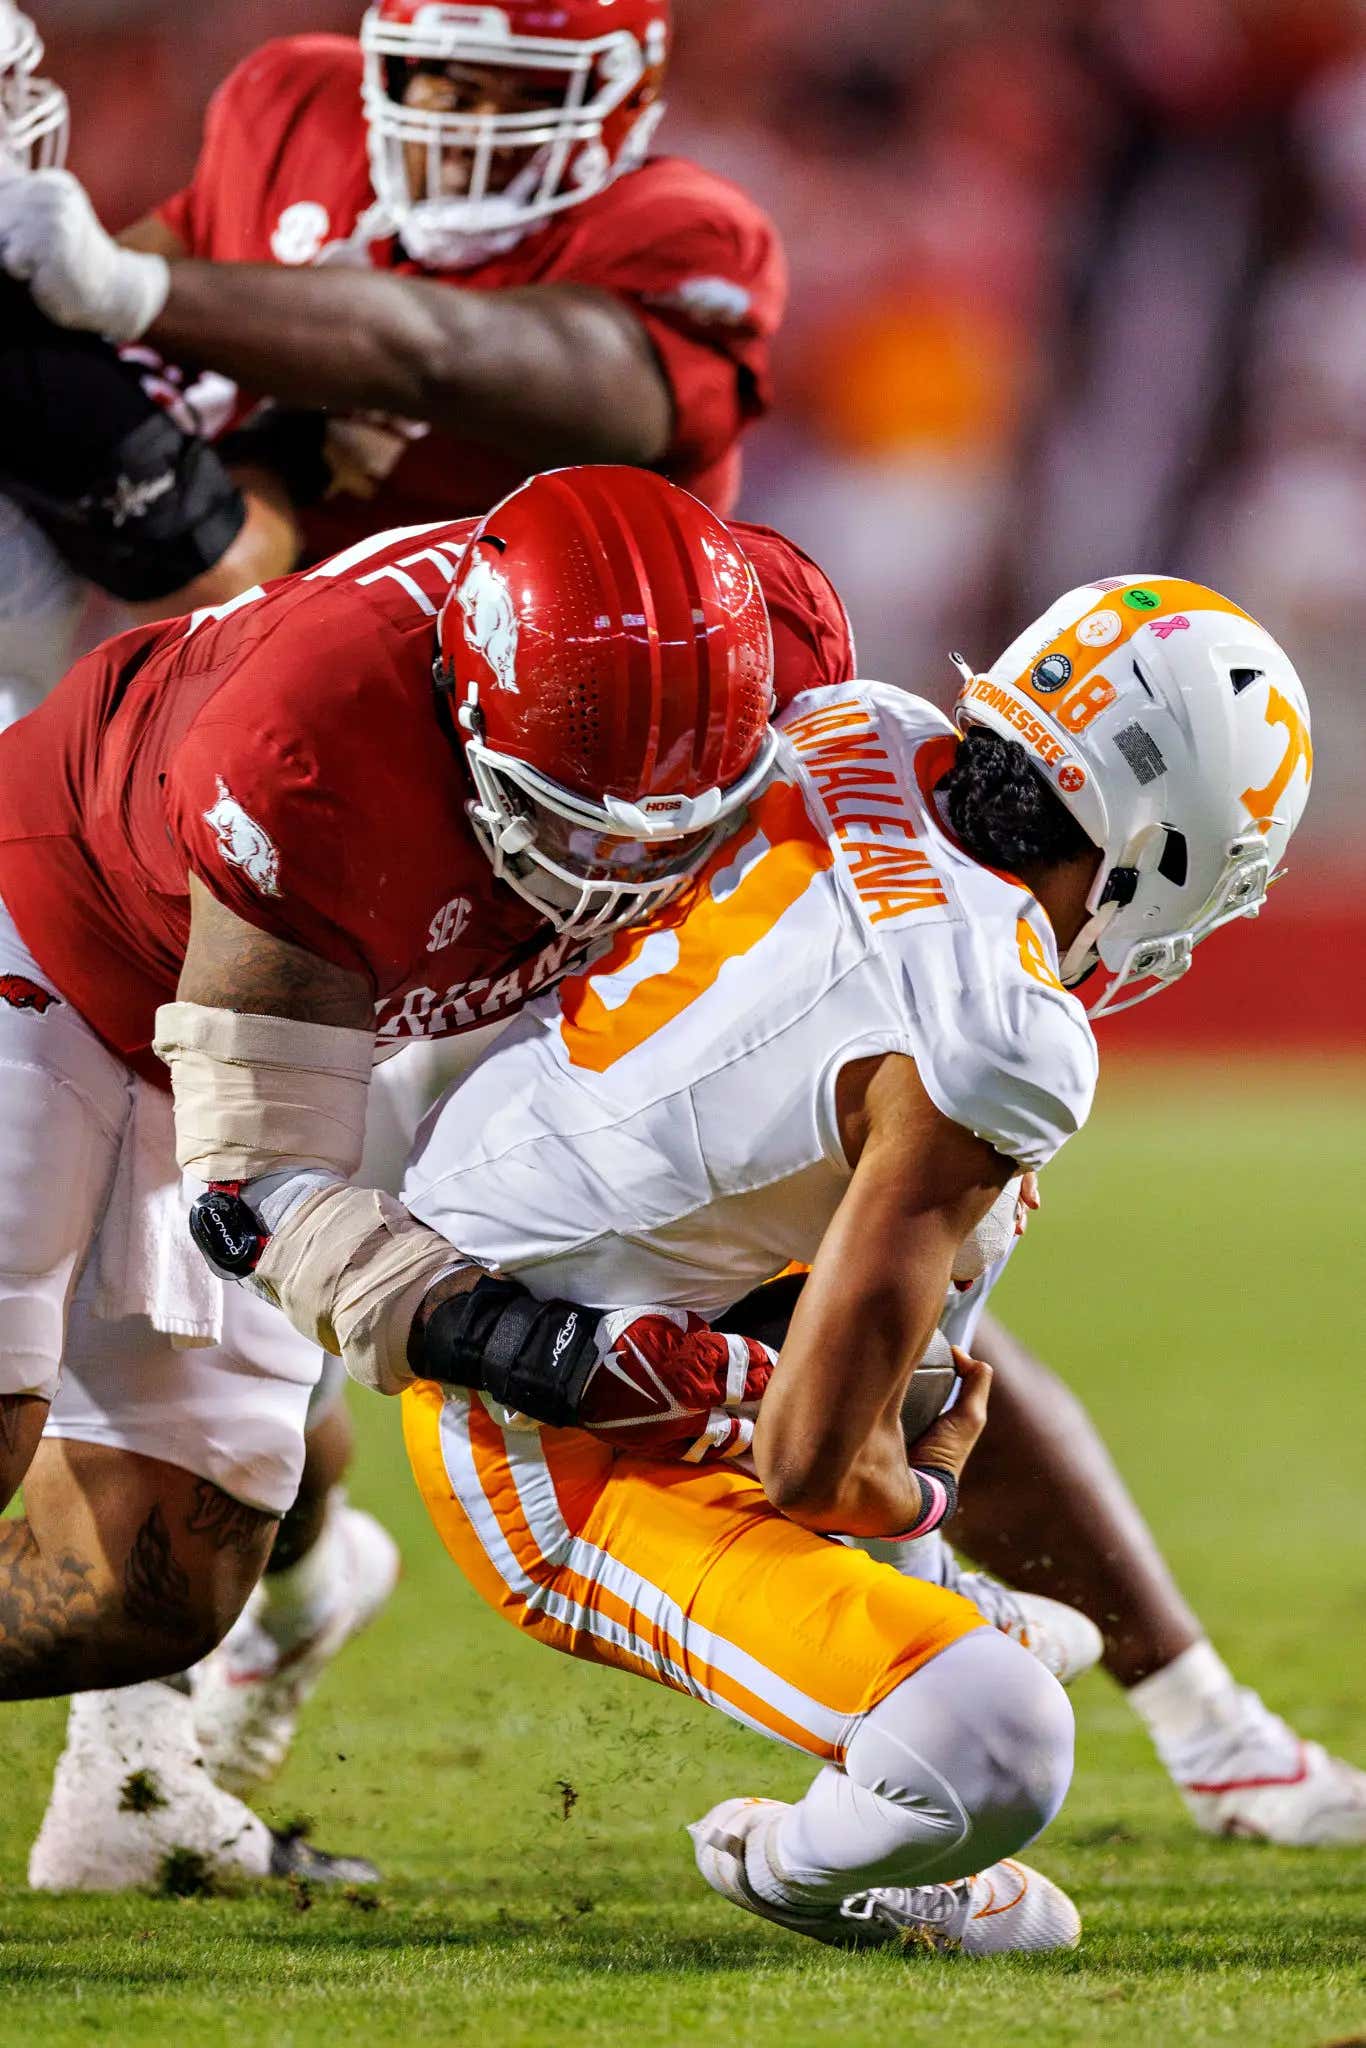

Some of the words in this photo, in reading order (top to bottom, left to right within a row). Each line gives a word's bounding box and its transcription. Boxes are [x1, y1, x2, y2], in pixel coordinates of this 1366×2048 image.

[970, 679, 1066, 768] TENNESSEE
[1057, 674, 1117, 734] 8
[644, 801, 682, 811] HOGS
[781, 700, 949, 926] IAMALEAVA
[426, 897, 473, 953] SEC
[374, 932, 582, 1035] RKAN
[207, 1206, 239, 1255] DONJOY
[552, 1312, 578, 1361] DONJOY
